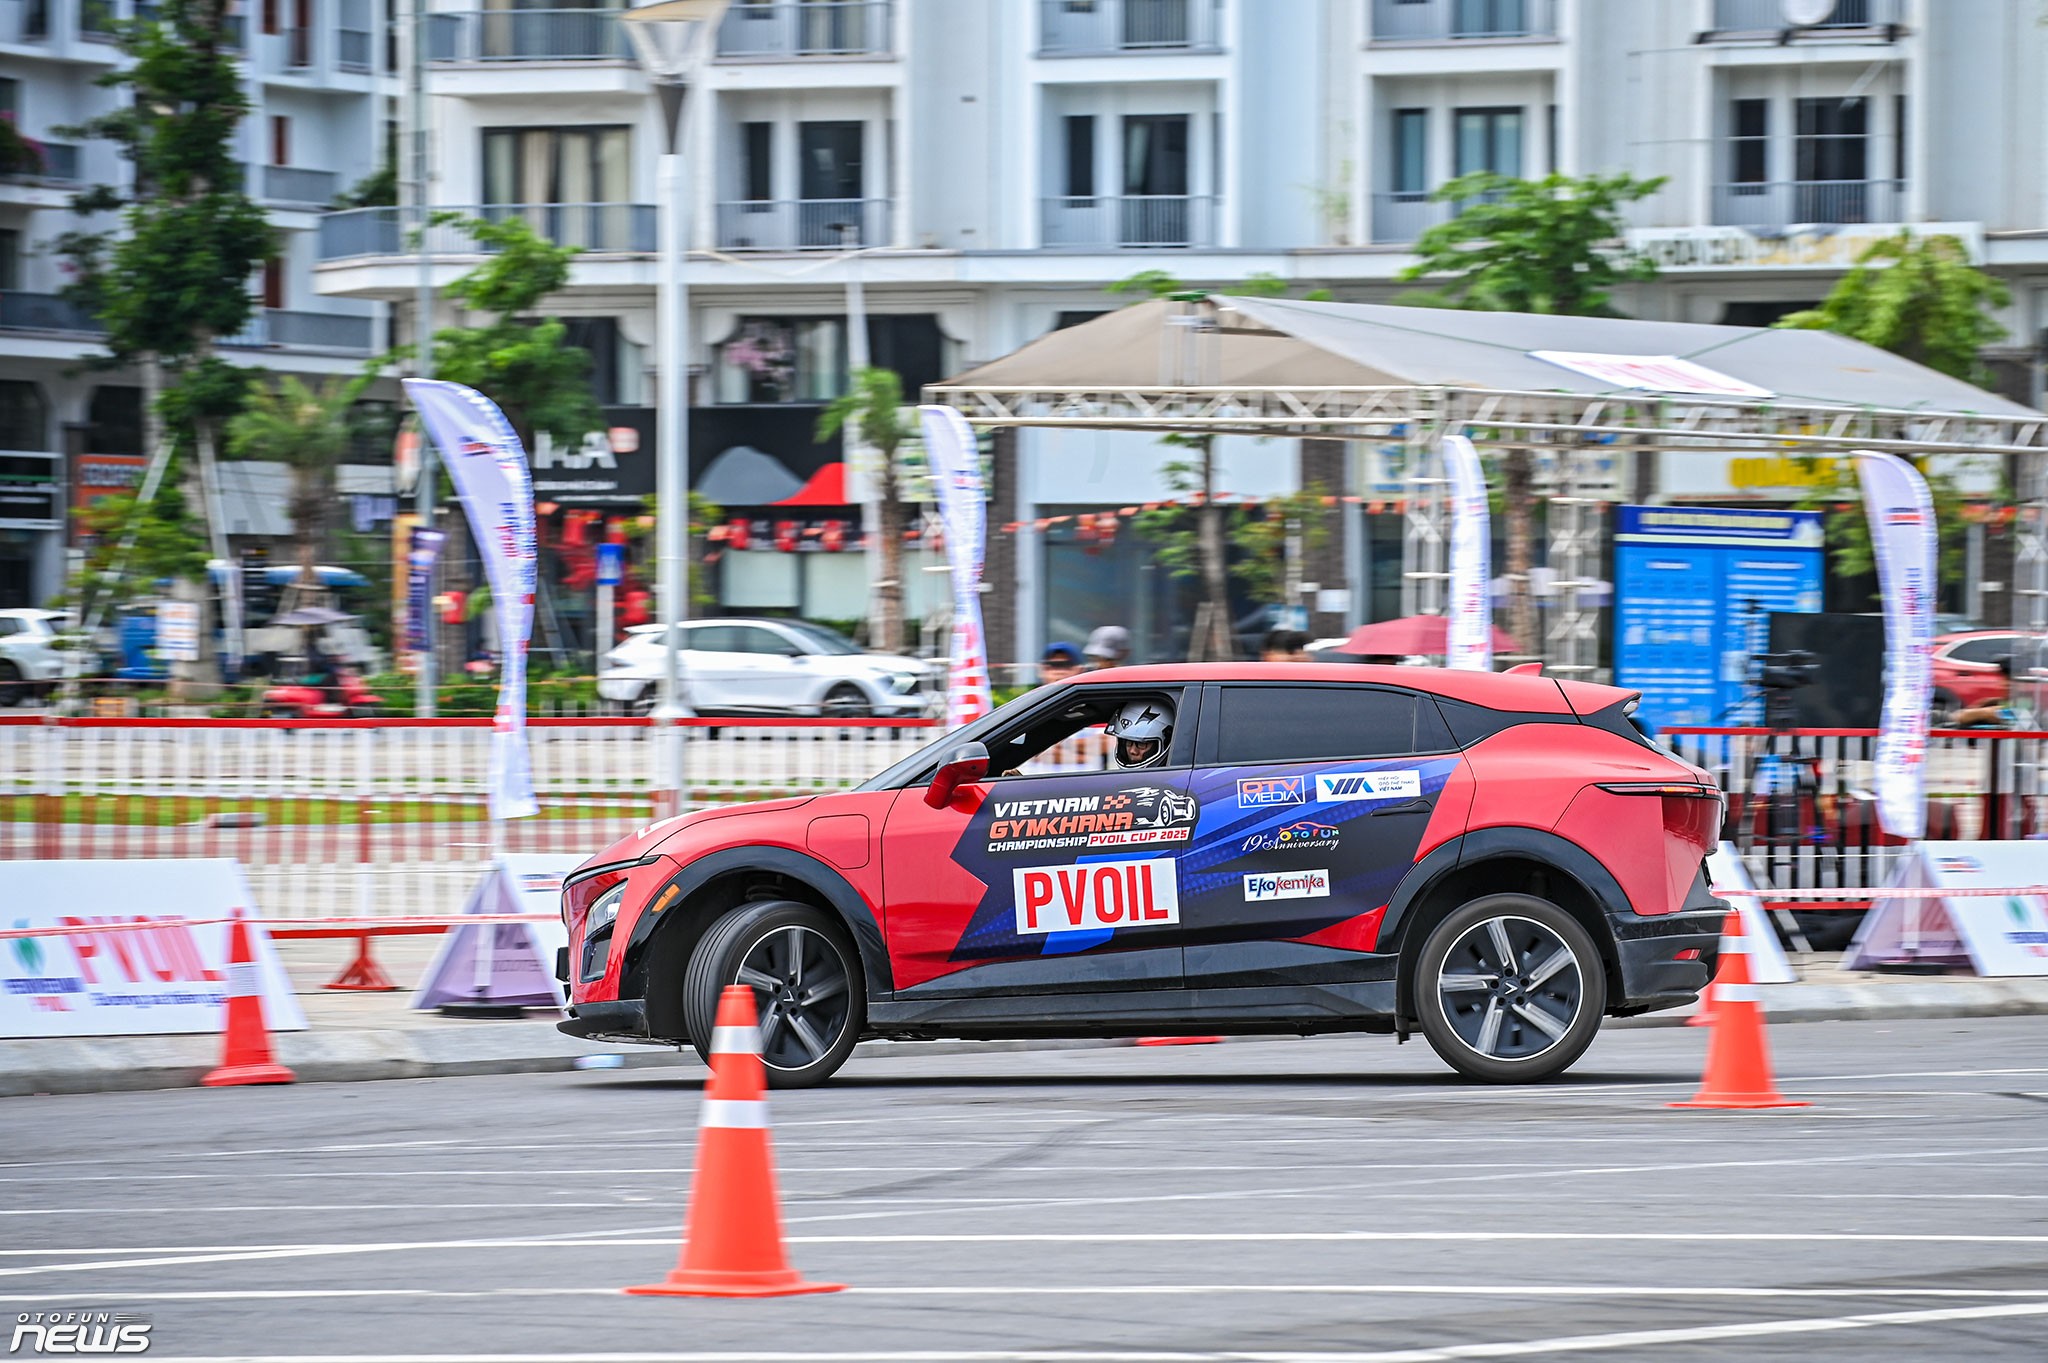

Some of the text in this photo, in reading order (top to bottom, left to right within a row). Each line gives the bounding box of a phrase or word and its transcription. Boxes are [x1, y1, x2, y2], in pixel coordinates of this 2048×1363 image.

[994, 796, 1100, 818] VIETNAM
[1243, 791, 1302, 804] MEDIA
[989, 812, 1134, 839] GYMKHANA
[987, 829, 1188, 852] CHAMPIONSHIP PVOIL CUP 2025
[1262, 836, 1340, 852] Anniversary
[1023, 864, 1169, 929] PVOIL
